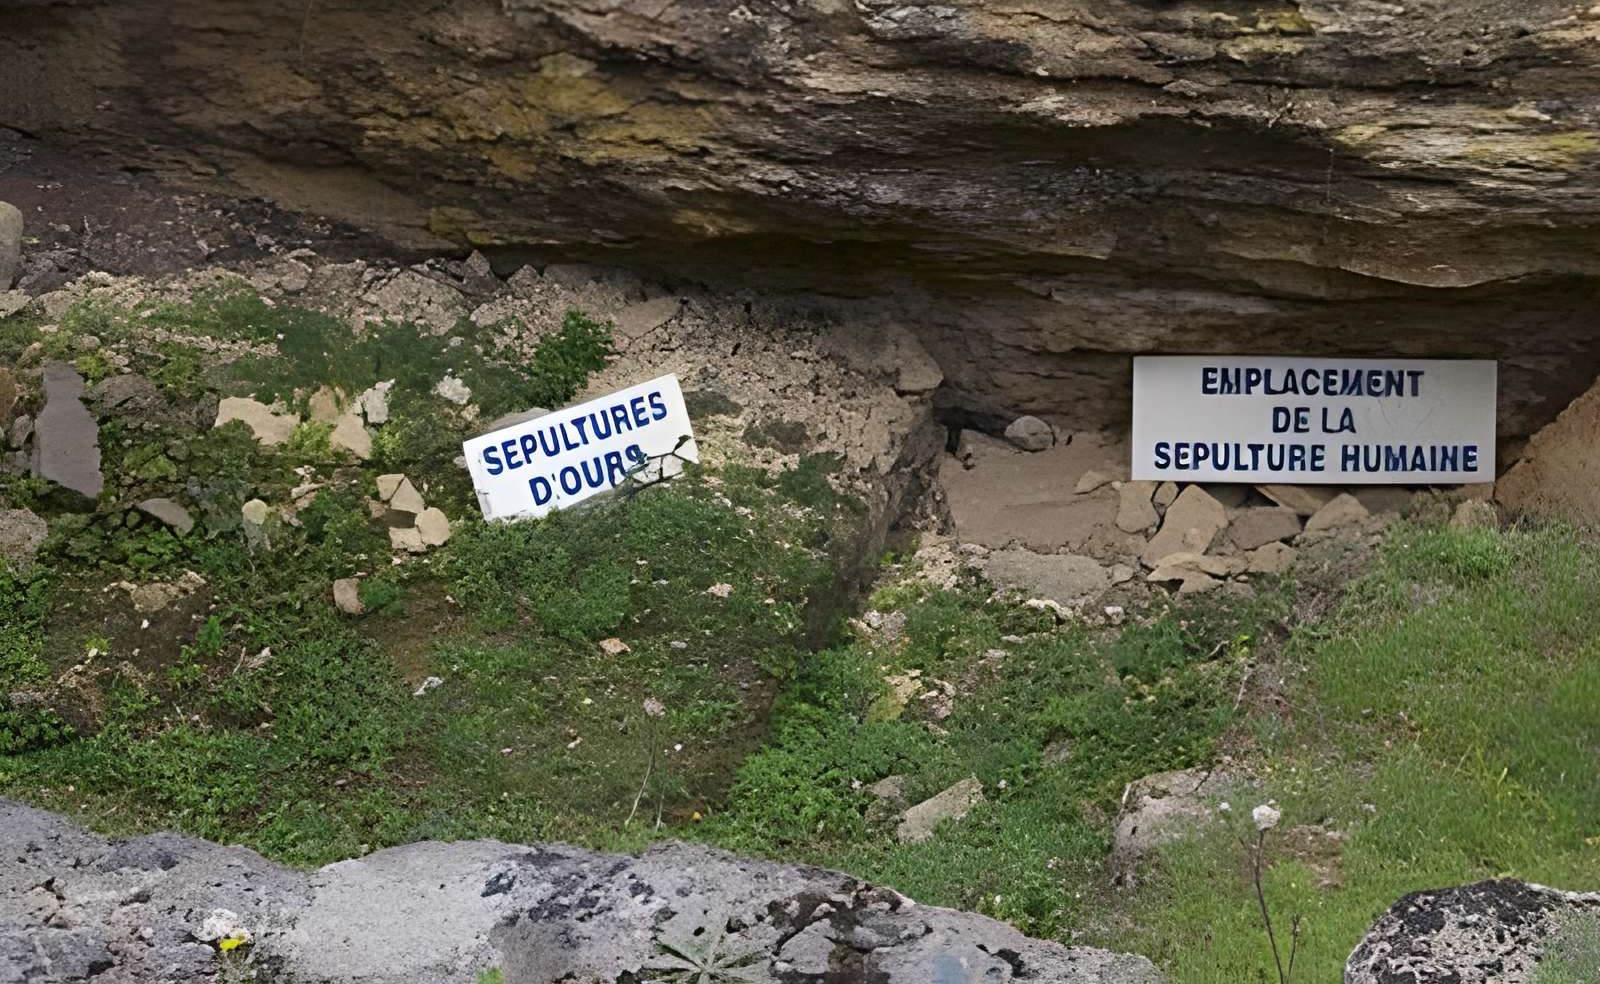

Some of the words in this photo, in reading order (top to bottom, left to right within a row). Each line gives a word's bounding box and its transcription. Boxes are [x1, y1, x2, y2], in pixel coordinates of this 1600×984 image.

[1201, 367, 1425, 397] EMPLACEMENT
[482, 391, 668, 476] SEPULTURES
[1272, 406, 1311, 434] DE
[1321, 407, 1357, 434] LA
[1153, 442, 1326, 472] SEPULTURE
[1341, 444, 1479, 473] HUMAINE
